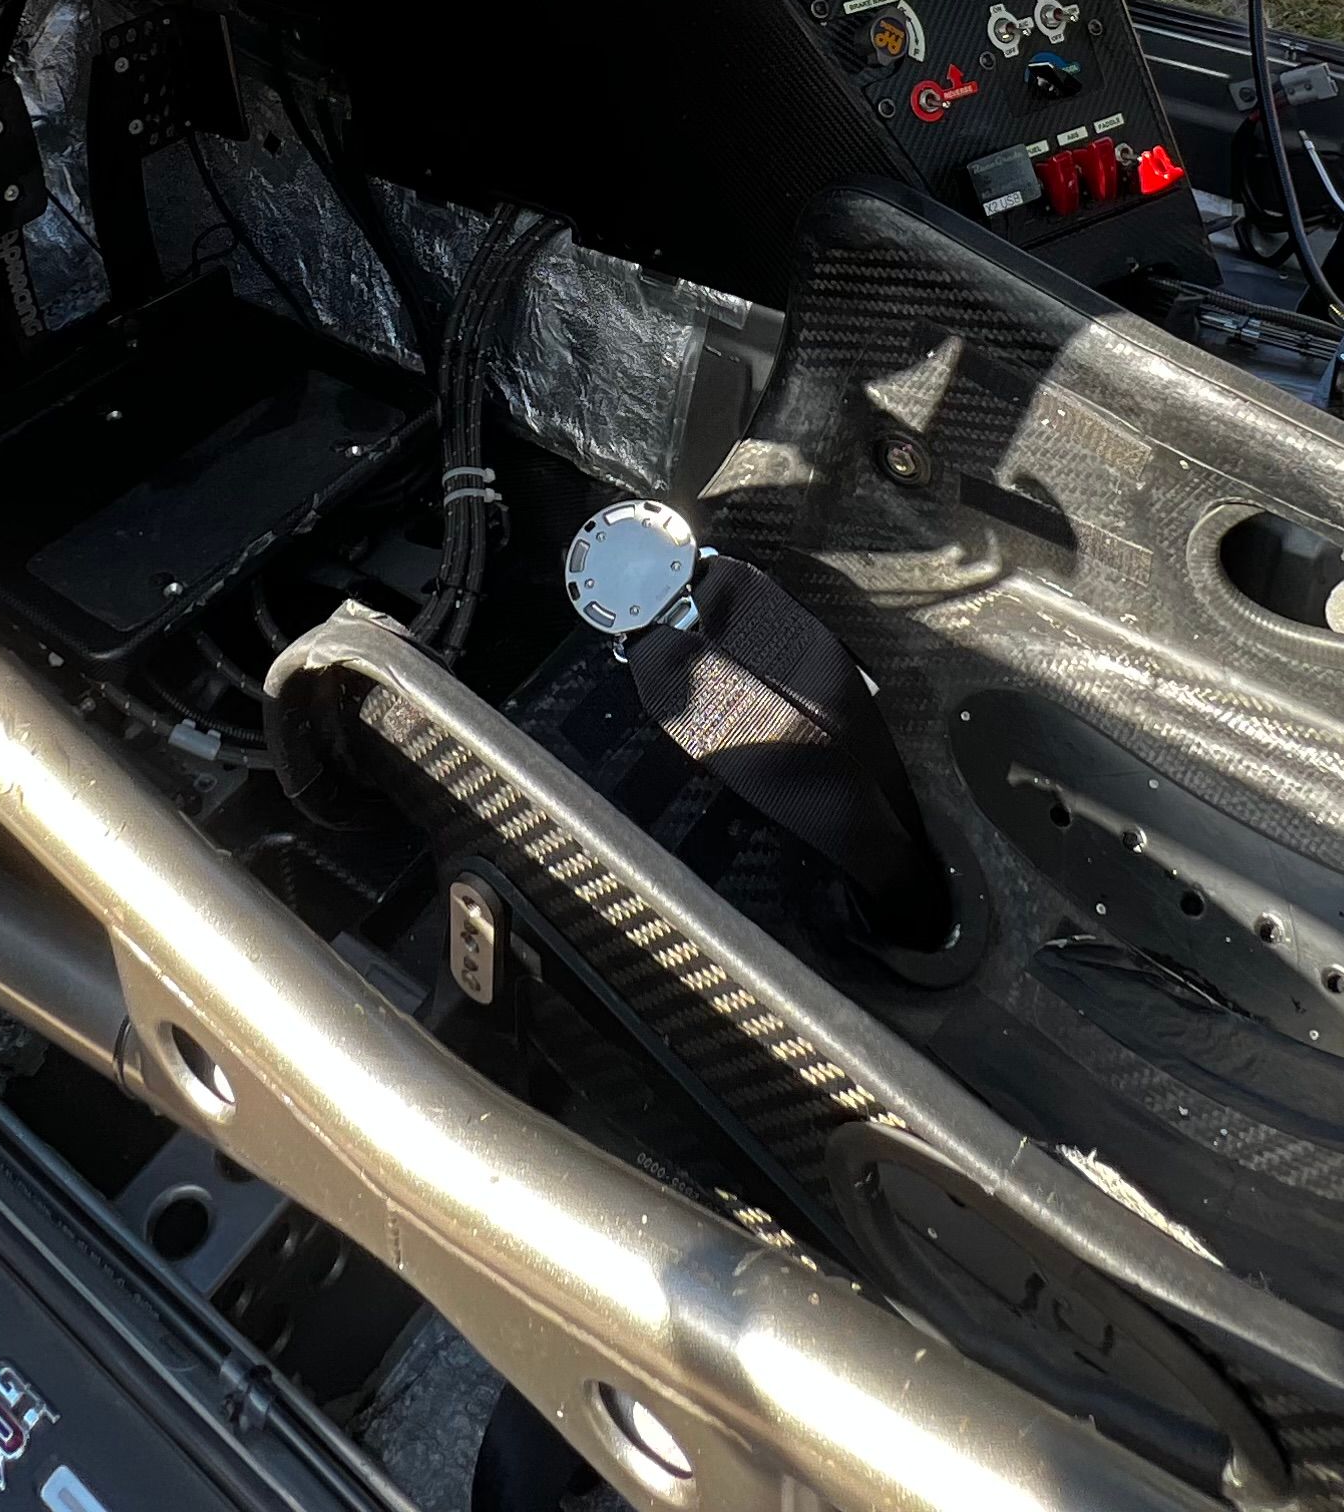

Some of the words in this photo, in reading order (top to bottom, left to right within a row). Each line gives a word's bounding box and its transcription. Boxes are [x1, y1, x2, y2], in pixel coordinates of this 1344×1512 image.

[1052, 34, 1062, 42] OFF
[1005, 47, 1017, 56] OFF
[944, 84, 973, 98] REVERSE
[1098, 116, 1120, 130] PADDLE
[985, 202, 998, 214] X2
[1000, 194, 1021, 209] USB
